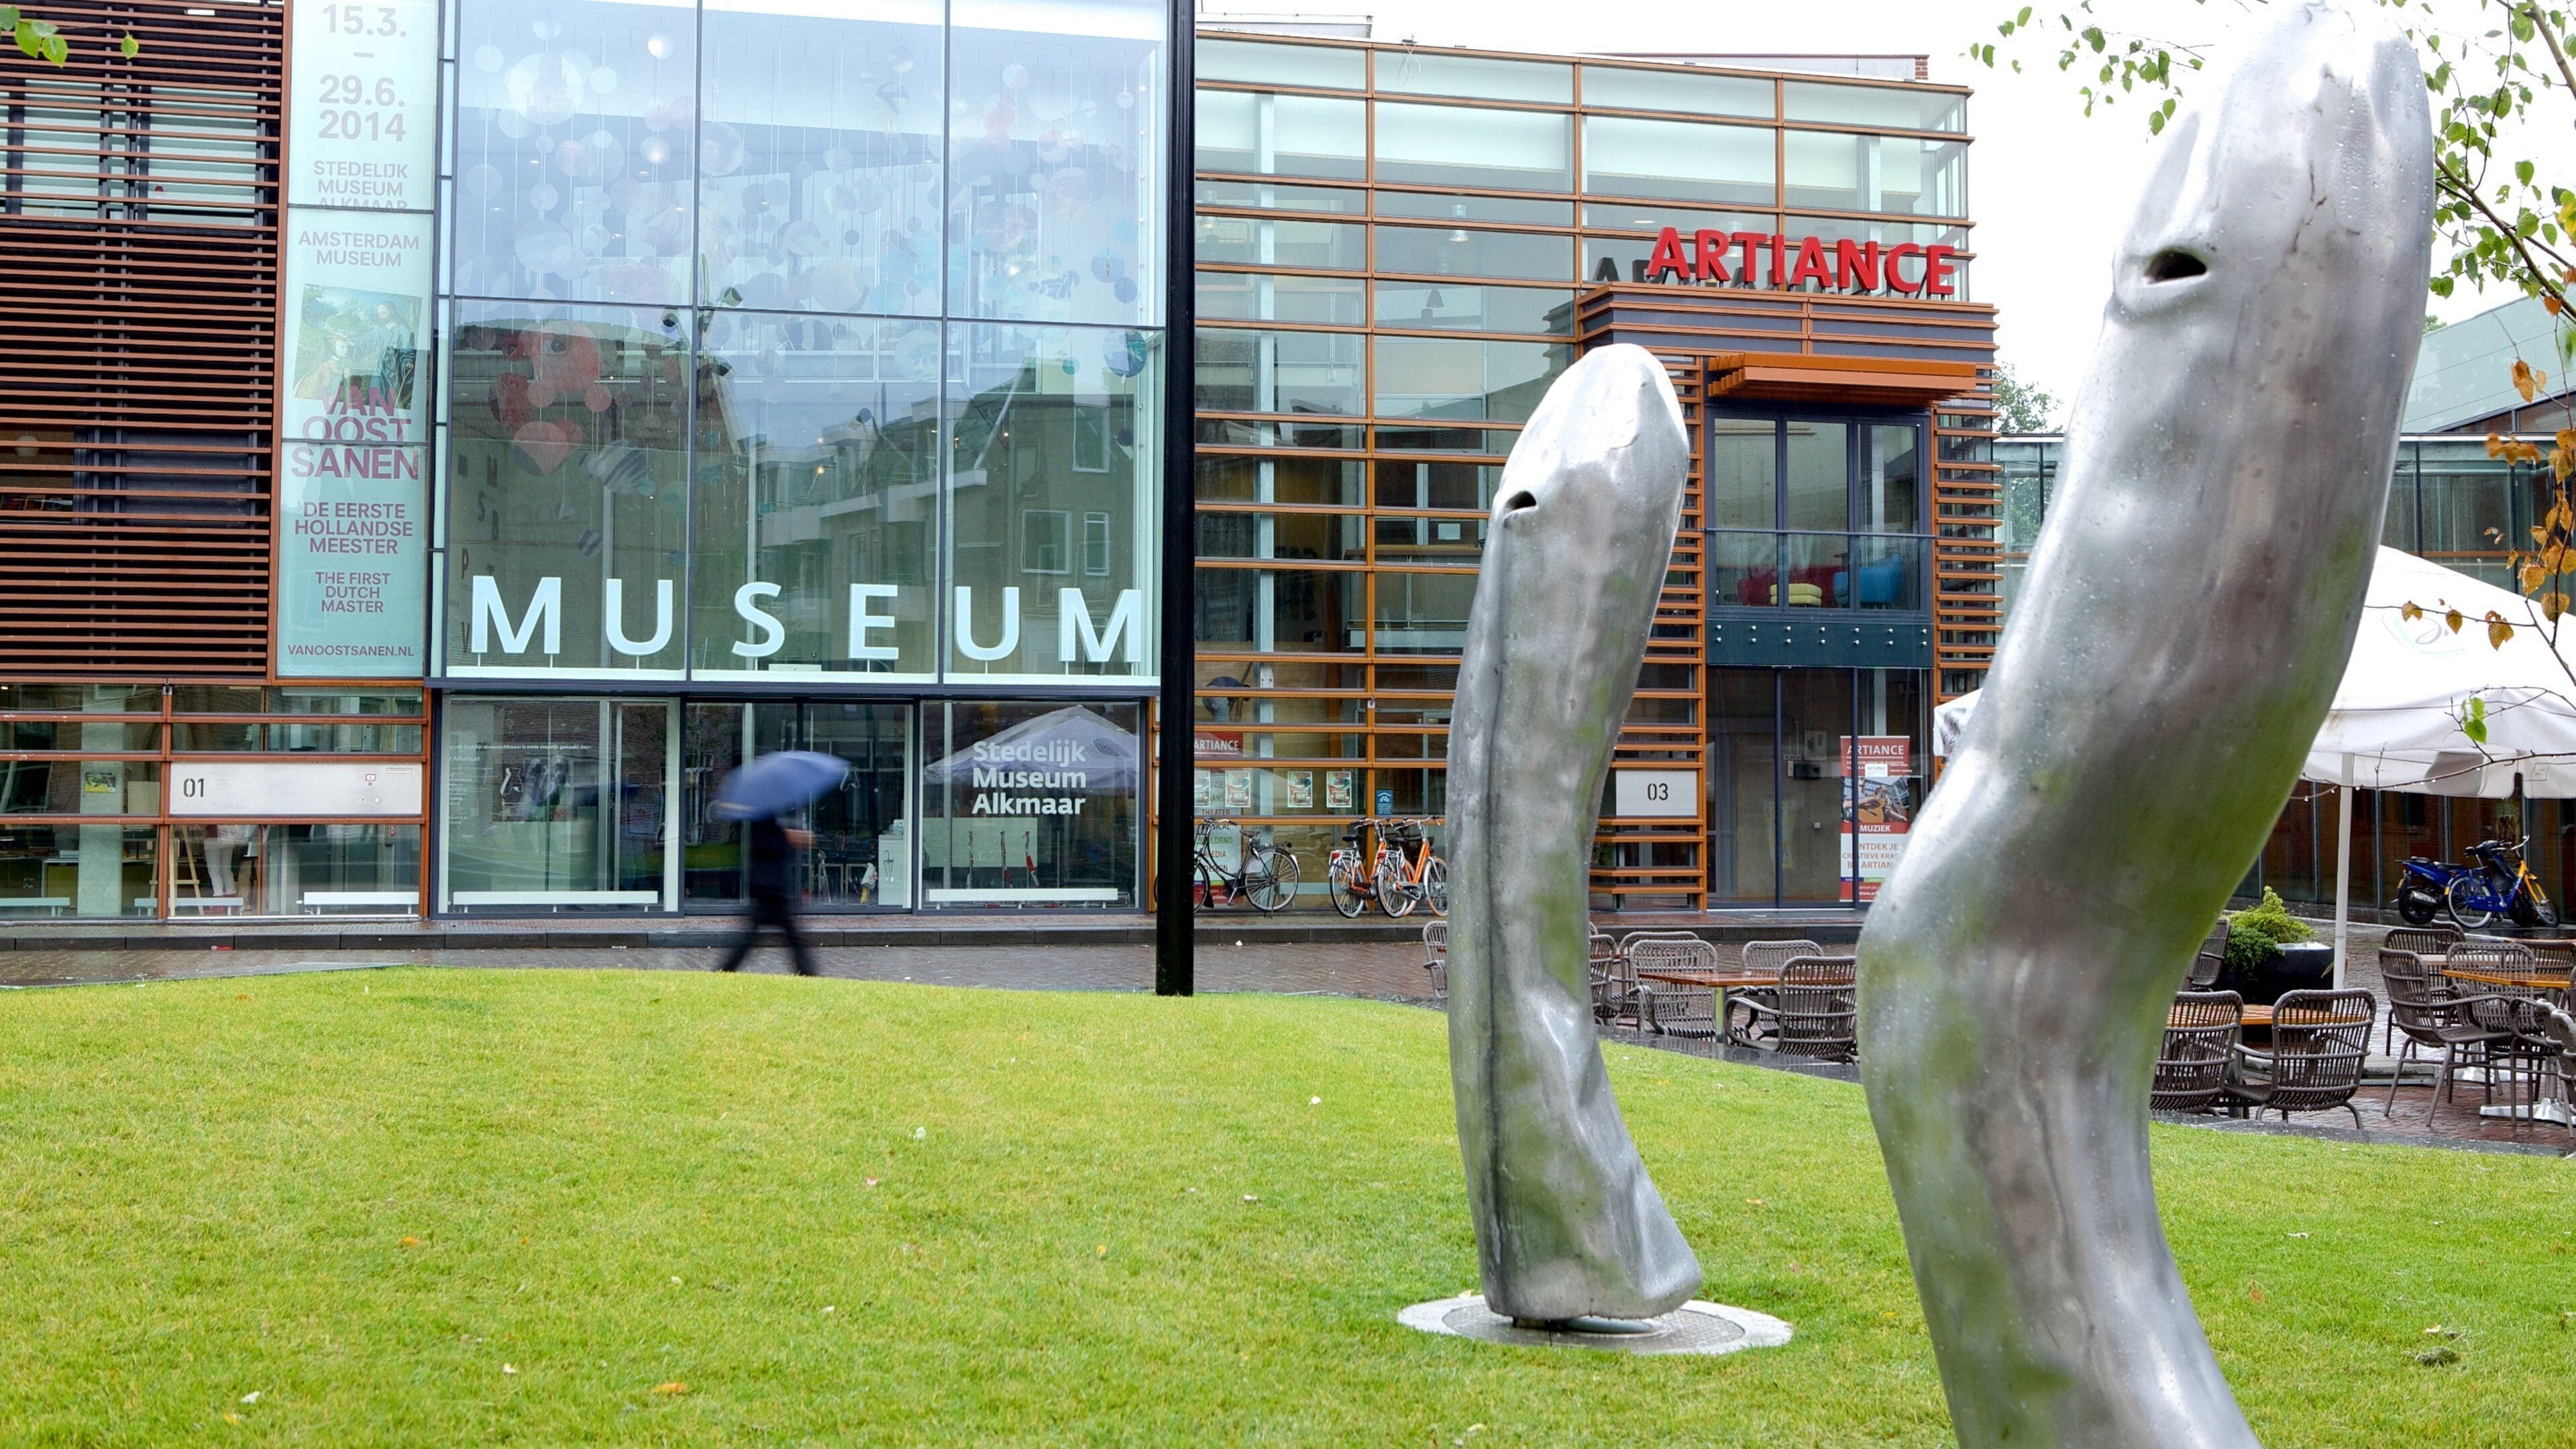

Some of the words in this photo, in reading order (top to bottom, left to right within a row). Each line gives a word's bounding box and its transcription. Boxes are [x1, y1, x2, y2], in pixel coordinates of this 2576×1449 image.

[323, 3, 407, 38] 15.3.
[319, 74, 405, 107] 29.6.
[318, 109, 406, 142] 2014
[313, 160, 409, 179] STEDELIJK
[318, 178, 403, 197] MUSEUM
[298, 230, 420, 250] AMSTERDAM
[316, 250, 402, 268] MUSEUM
[1646, 226, 1955, 295] ARTIANCE
[316, 384, 396, 417] VAN
[302, 415, 412, 448] OOST
[291, 446, 419, 480] SANEN
[304, 502, 329, 517] DE
[335, 502, 405, 519] EERSTE
[294, 519, 413, 537] HOLLANDSE
[310, 537, 398, 554] MEESTER
[315, 572, 345, 584] THE
[349, 572, 390, 585] FIRST
[325, 586, 380, 599] DUTCH
[321, 600, 384, 613] MASTER
[472, 575, 1141, 663] MUSEUM
[287, 645, 415, 657] VANOOSTSANEN.NL
[973, 739, 1086, 767] Stedelijk
[1194, 739, 1239, 751] ARTIANCE
[973, 767, 1087, 788] Museum
[183, 778, 205, 798] 01
[1647, 782, 1669, 801] 03
[971, 792, 1086, 814] Alkmaar
[1860, 824, 1891, 833] MUZIEK
